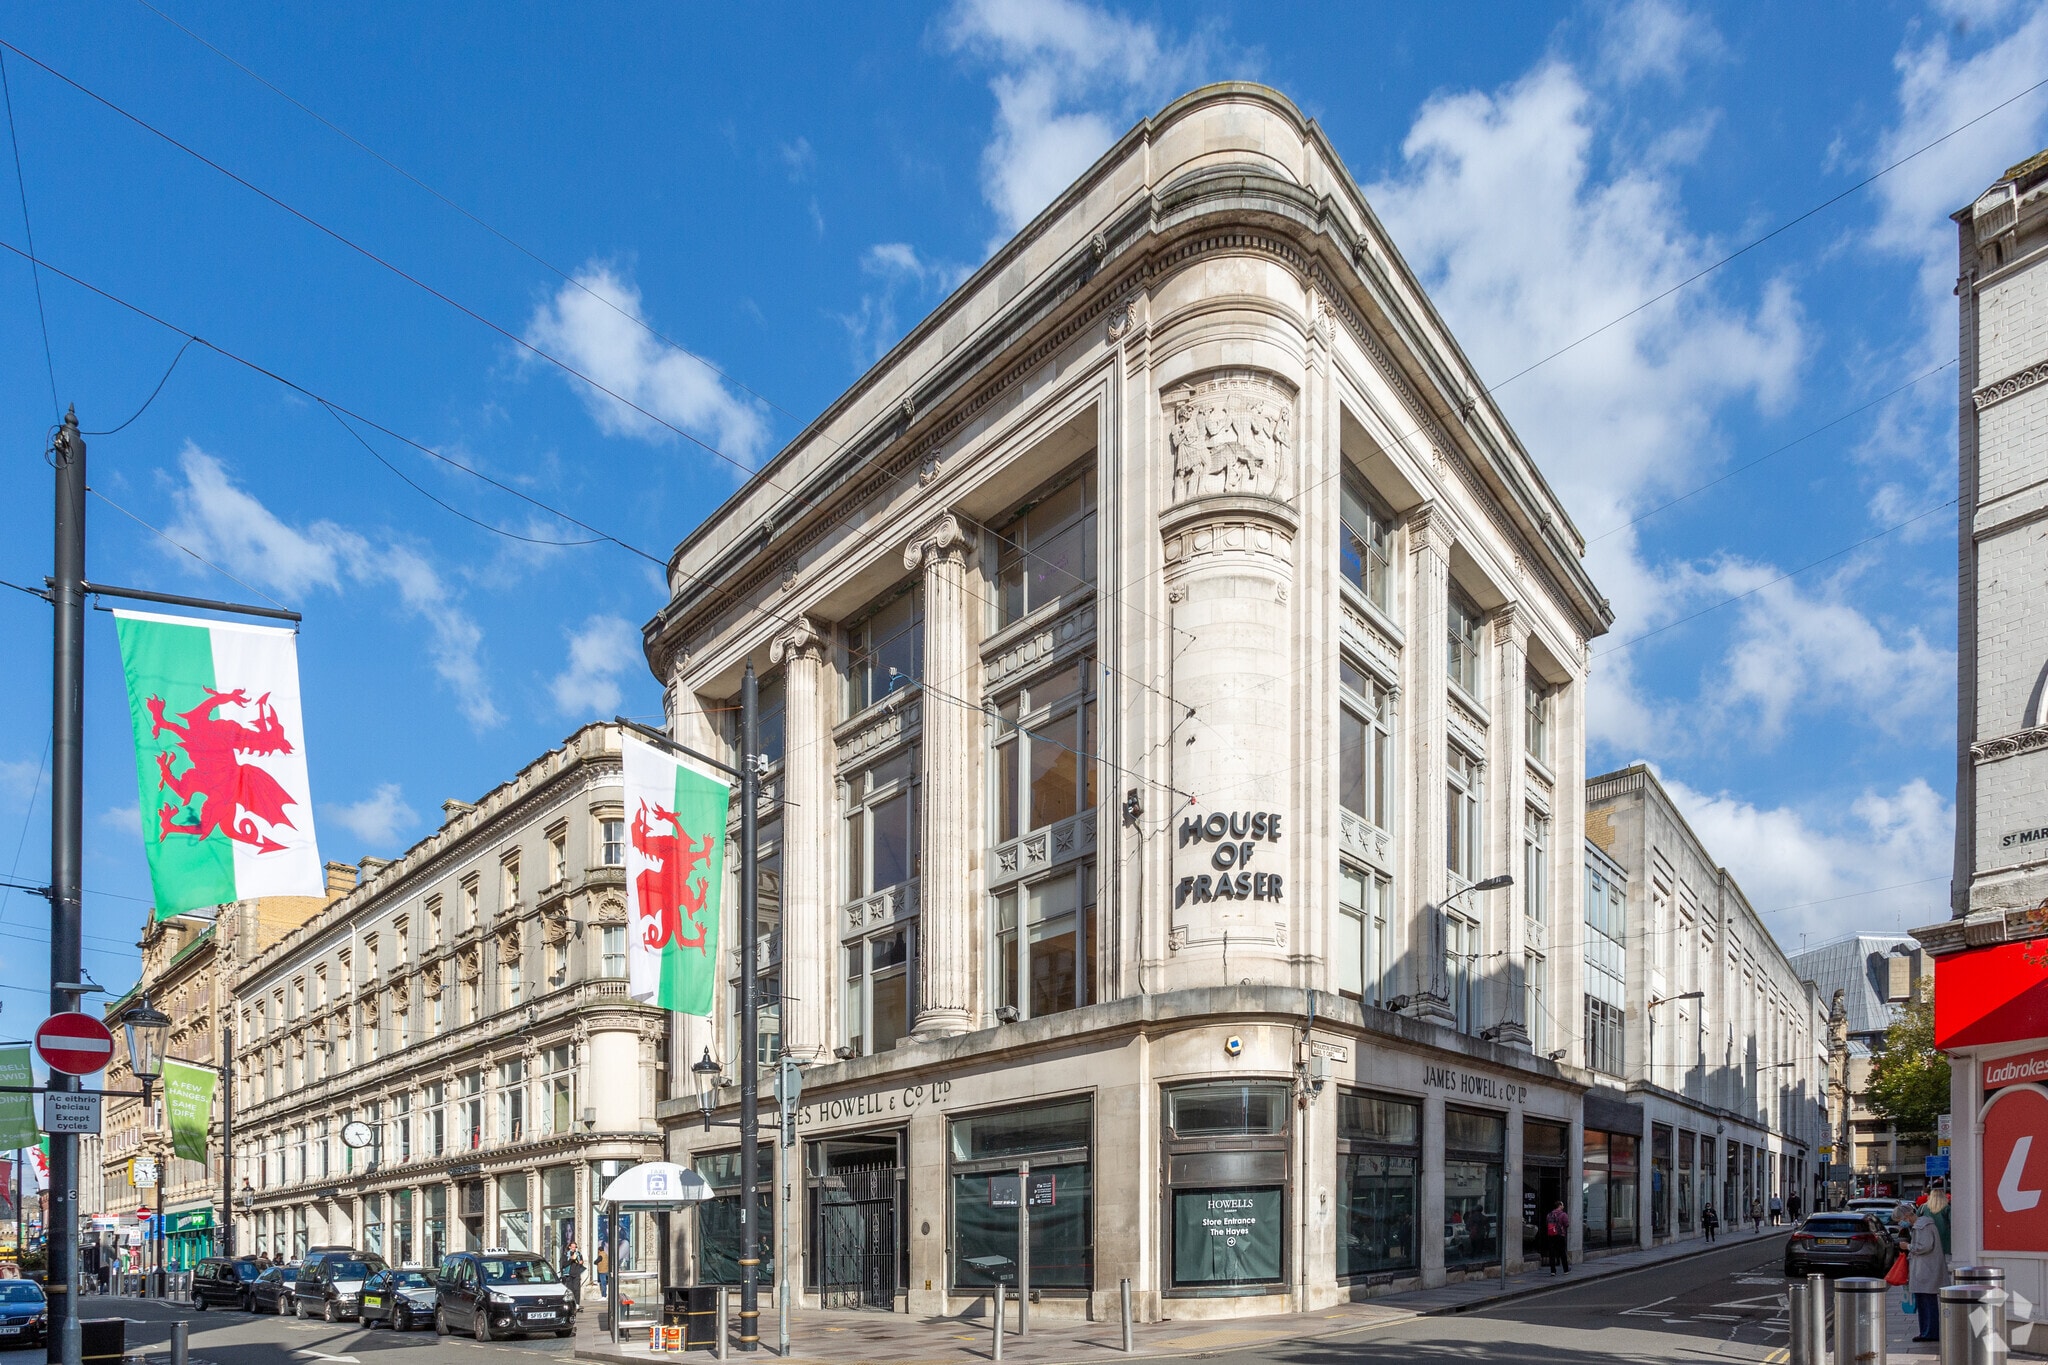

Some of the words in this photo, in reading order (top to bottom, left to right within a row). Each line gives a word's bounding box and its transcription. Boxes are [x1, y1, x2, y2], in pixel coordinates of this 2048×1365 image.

[1179, 811, 1282, 849] HOUSE
[1212, 842, 1255, 871] OF
[1175, 872, 1283, 910] FRASER
[181, 1082, 202, 1092] FEW
[1423, 1066, 1456, 1091] JAMES
[1461, 1074, 1497, 1098] HOWELL
[48, 1094, 62, 1102] Ac
[65, 1094, 97, 1103] eithrio
[820, 1094, 883, 1122] HOWELL
[56, 1114, 90, 1122] Except
[57, 1122, 88, 1130] cycles
[69, 1190, 77, 1200] 3
[1207, 1199, 1254, 1209] HOWELLS
[1202, 1218, 1222, 1226] Store
[1223, 1217, 1256, 1225] Entrance
[1210, 1228, 1224, 1236] The
[1225, 1228, 1249, 1236] Hayes
